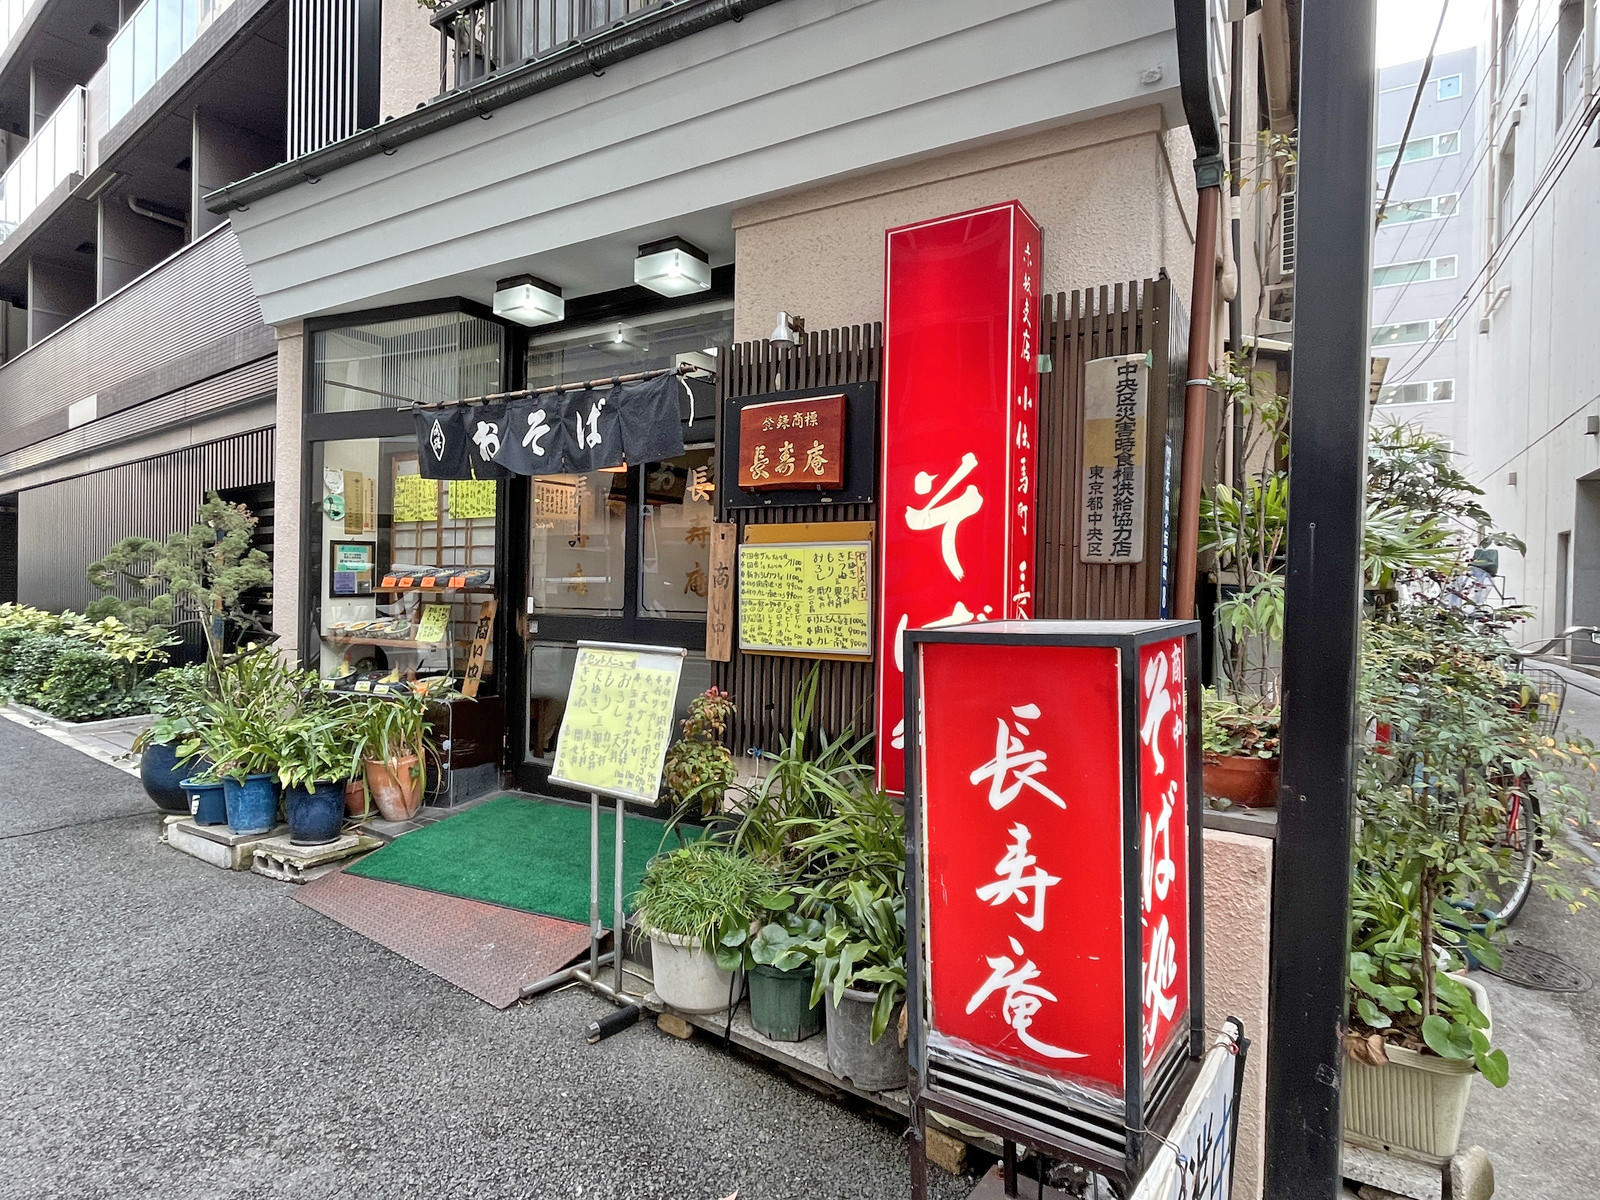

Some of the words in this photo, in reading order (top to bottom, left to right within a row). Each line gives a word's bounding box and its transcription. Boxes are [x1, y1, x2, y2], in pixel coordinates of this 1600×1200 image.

[472, 397, 607, 463] おそば
[1110, 361, 1139, 557] 中央区災害時食糧供給協力店
[1086, 464, 1105, 557] 東京都中央区
[601, 670, 614, 711] もり
[613, 672, 631, 717] おろし
[965, 703, 1092, 1059] 長寿庵
